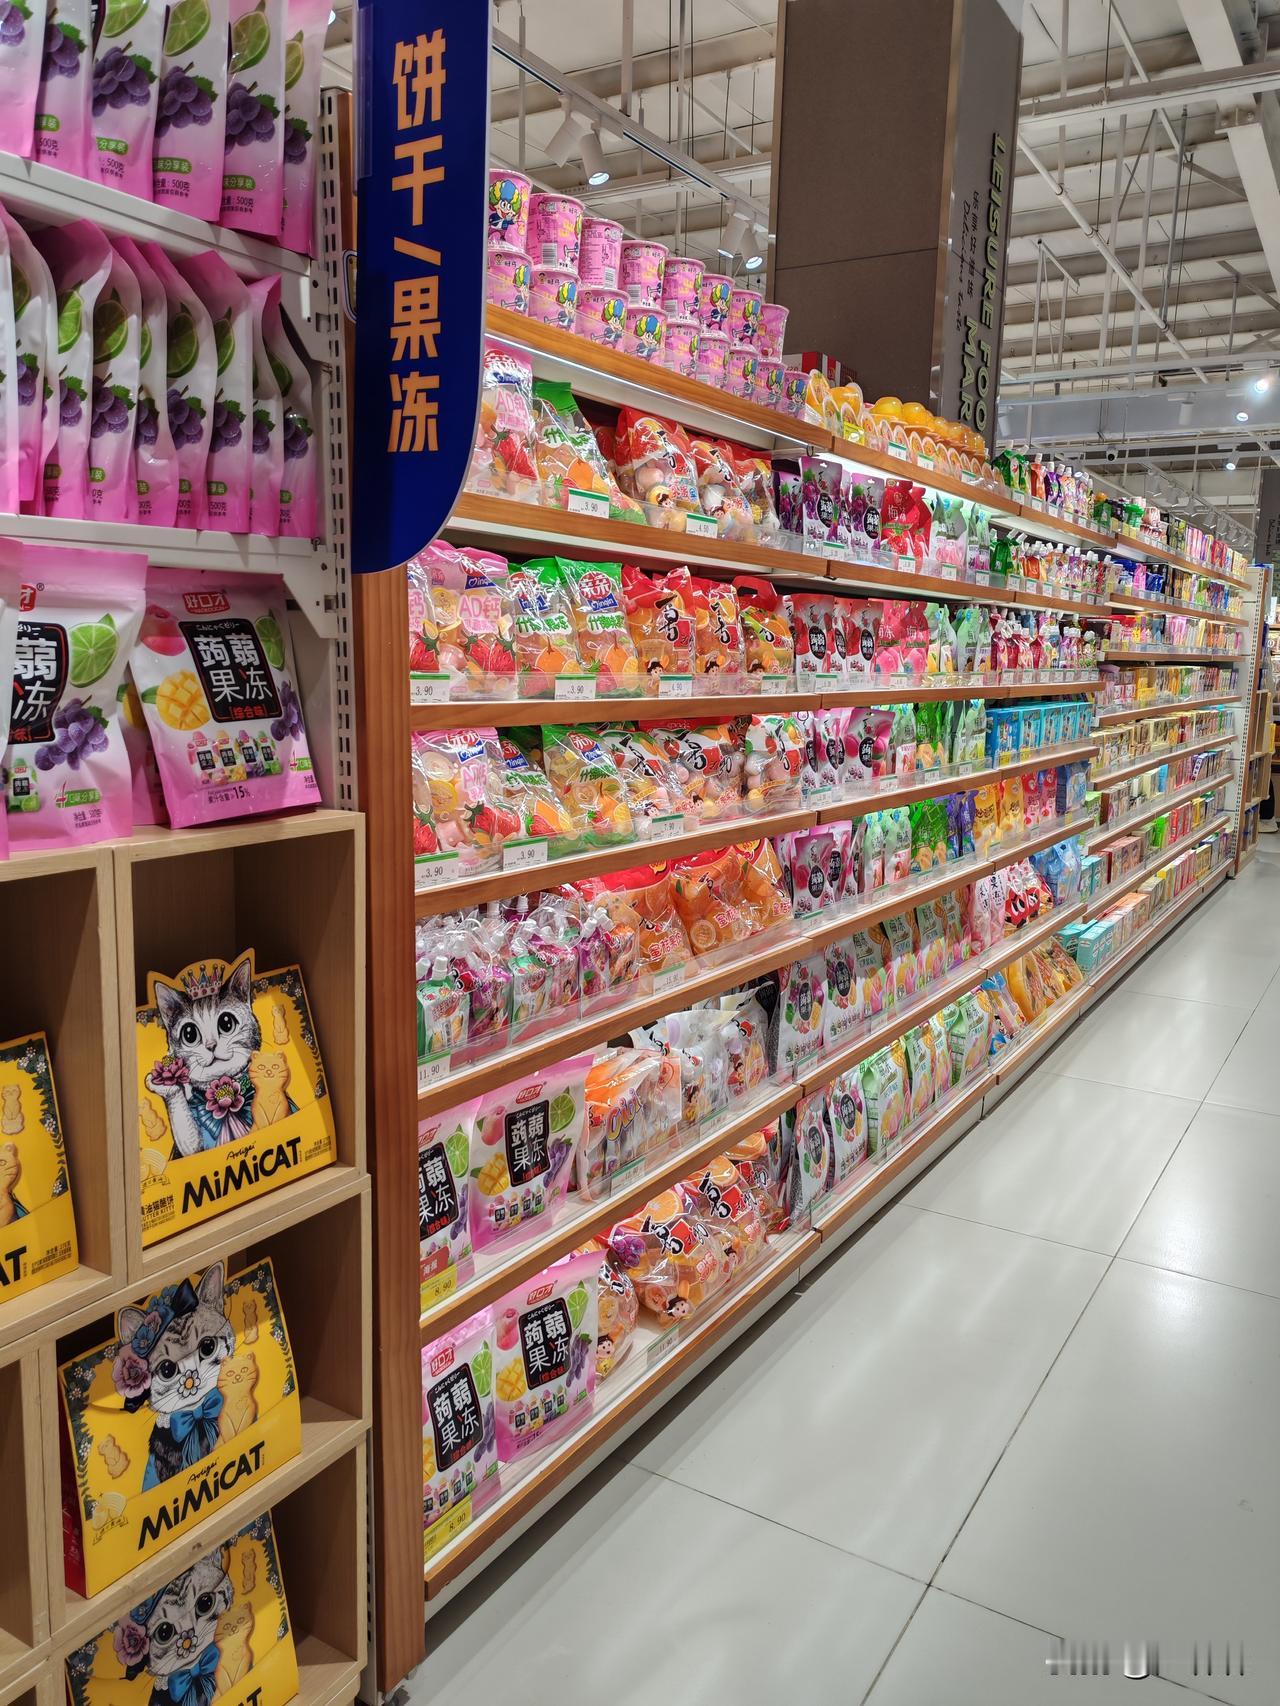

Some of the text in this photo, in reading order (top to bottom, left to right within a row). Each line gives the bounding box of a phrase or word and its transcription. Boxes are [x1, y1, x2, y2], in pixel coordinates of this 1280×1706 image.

[979, 131, 1007, 330] LEISURE
[584, 502, 598, 512] 3.90
[185, 593, 226, 609] 好口才
[193, 632, 261, 669] 蒟蒻
[209, 666, 274, 704] 果冻
[415, 686, 434, 696] 3.90
[569, 685, 584, 695] 3.90
[519, 849, 535, 861] 3.90
[425, 866, 443, 879] 3.90
[511, 1113, 545, 1147] 蒟蒻
[513, 1137, 546, 1173] 果冻
[434, 1280, 452, 1297] 8.90
[529, 1286, 554, 1303] 好口才
[524, 1309, 568, 1350] 蒟蒻
[431, 1348, 454, 1374] 好口才
[529, 1336, 570, 1375] 果冻
[433, 1378, 473, 1427] 蒟蒻
[441, 1406, 480, 1455] 果冻
[449, 1512, 466, 1532] 8.90
